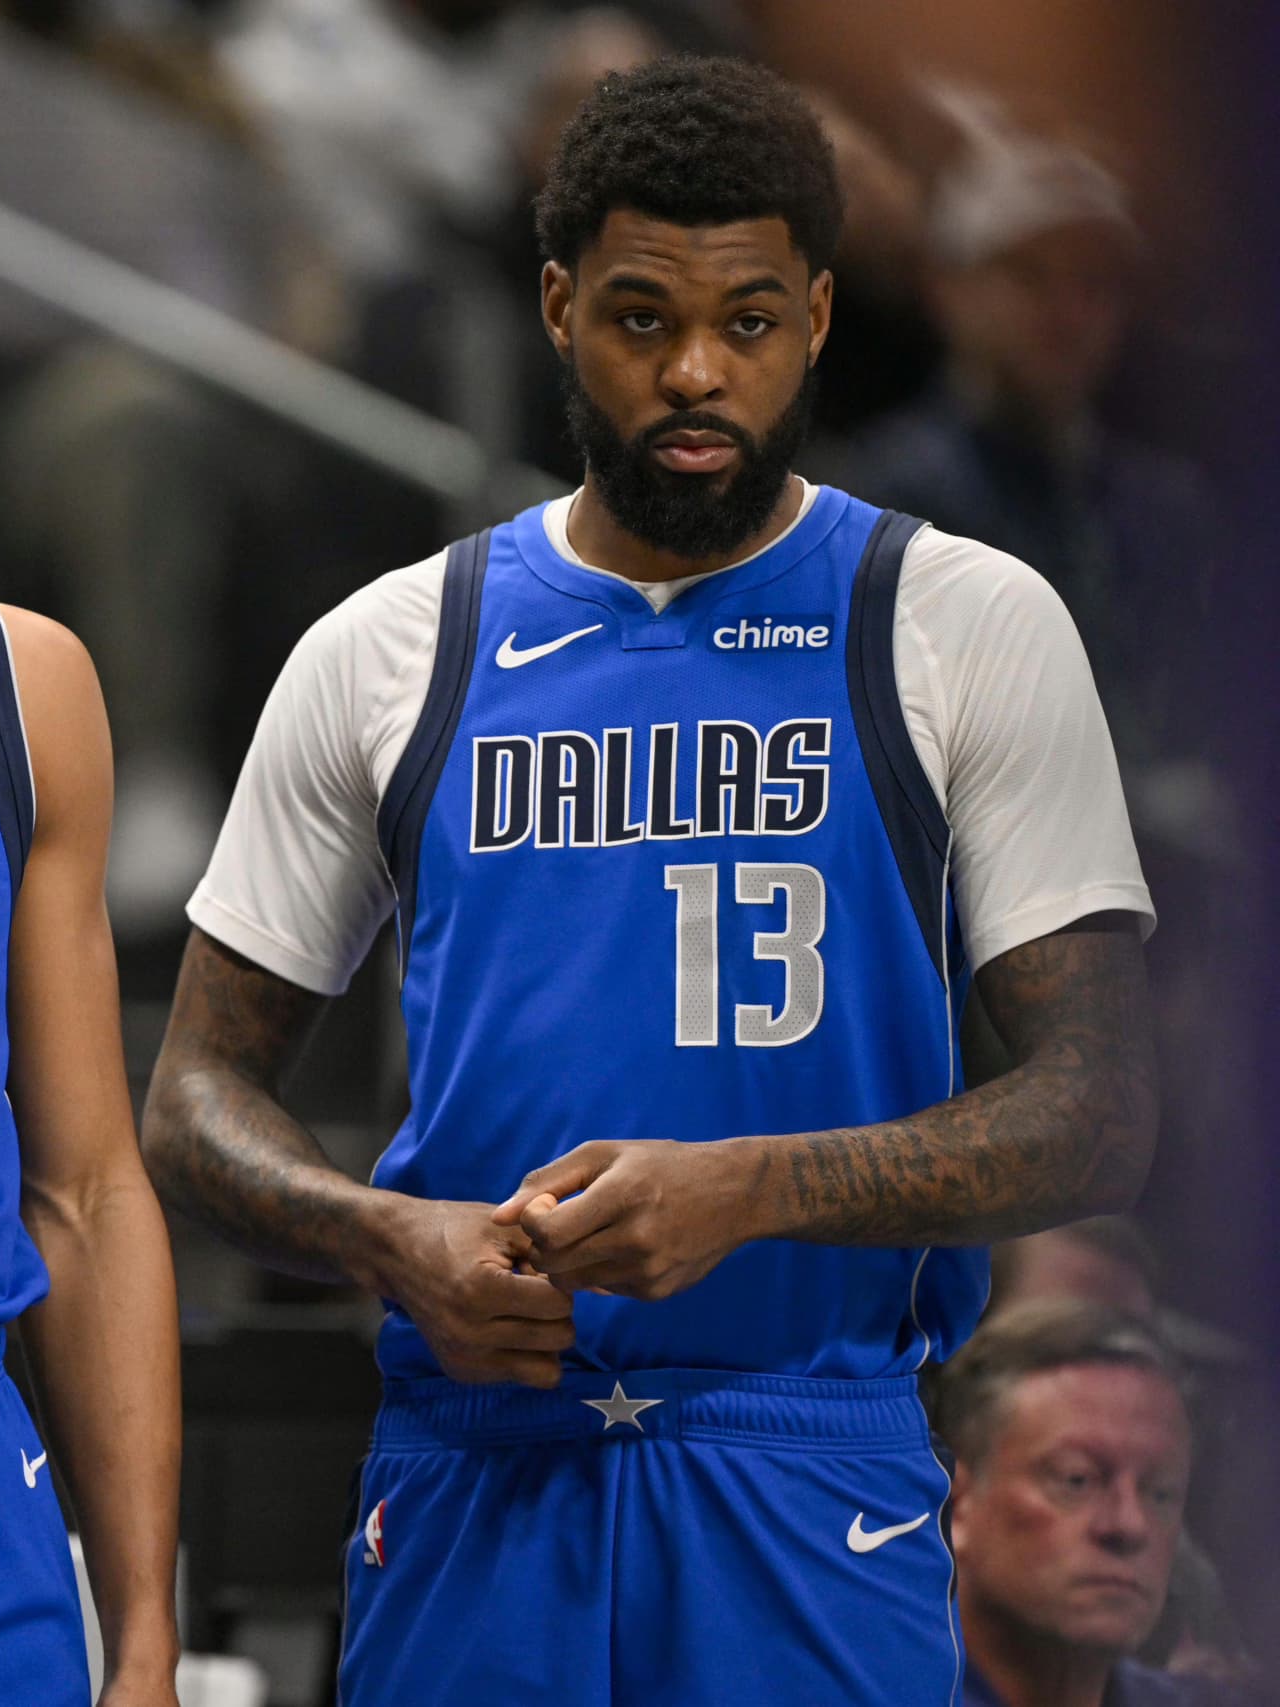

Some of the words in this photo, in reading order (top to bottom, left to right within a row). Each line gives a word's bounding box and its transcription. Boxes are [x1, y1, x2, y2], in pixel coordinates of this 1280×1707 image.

[713, 618, 830, 649] chime
[469, 718, 832, 853] DALLAS
[664, 862, 826, 1047] 13
